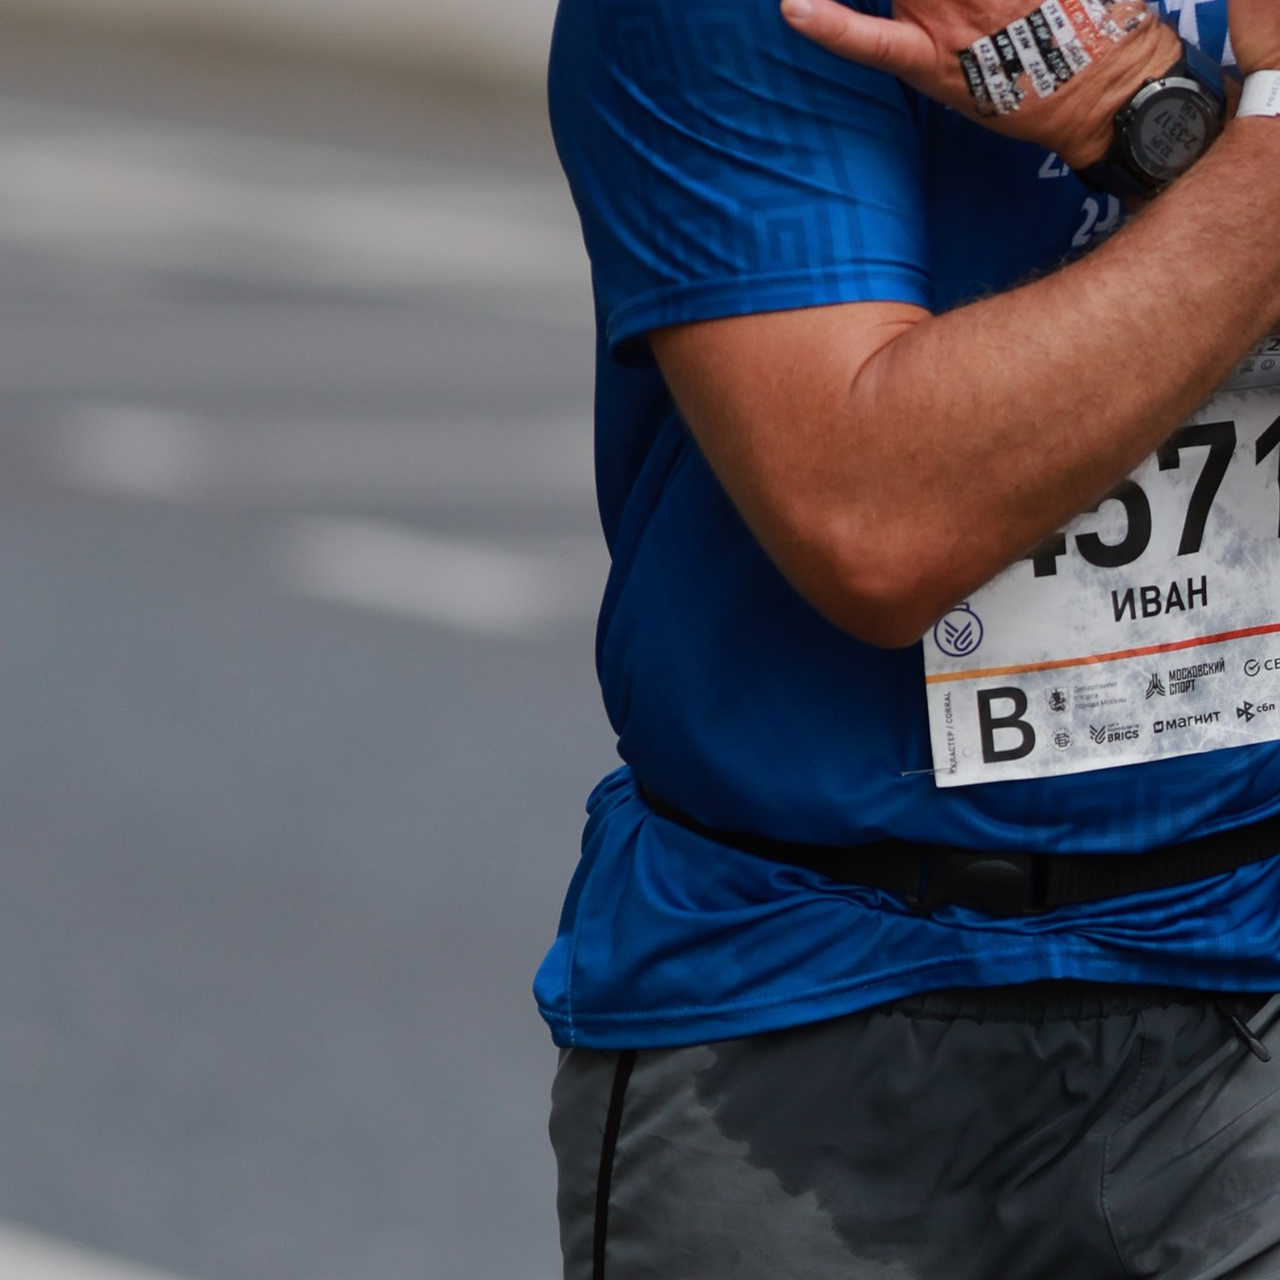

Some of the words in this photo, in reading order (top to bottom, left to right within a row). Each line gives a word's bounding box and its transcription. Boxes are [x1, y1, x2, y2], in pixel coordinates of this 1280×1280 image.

[1111, 575, 1208, 622] ИВАН
[1168, 658, 1226, 684] МОСКОВСКИЙ
[1169, 679, 1197, 696] СПОРТ
[1107, 729, 1140, 743] BRICS
